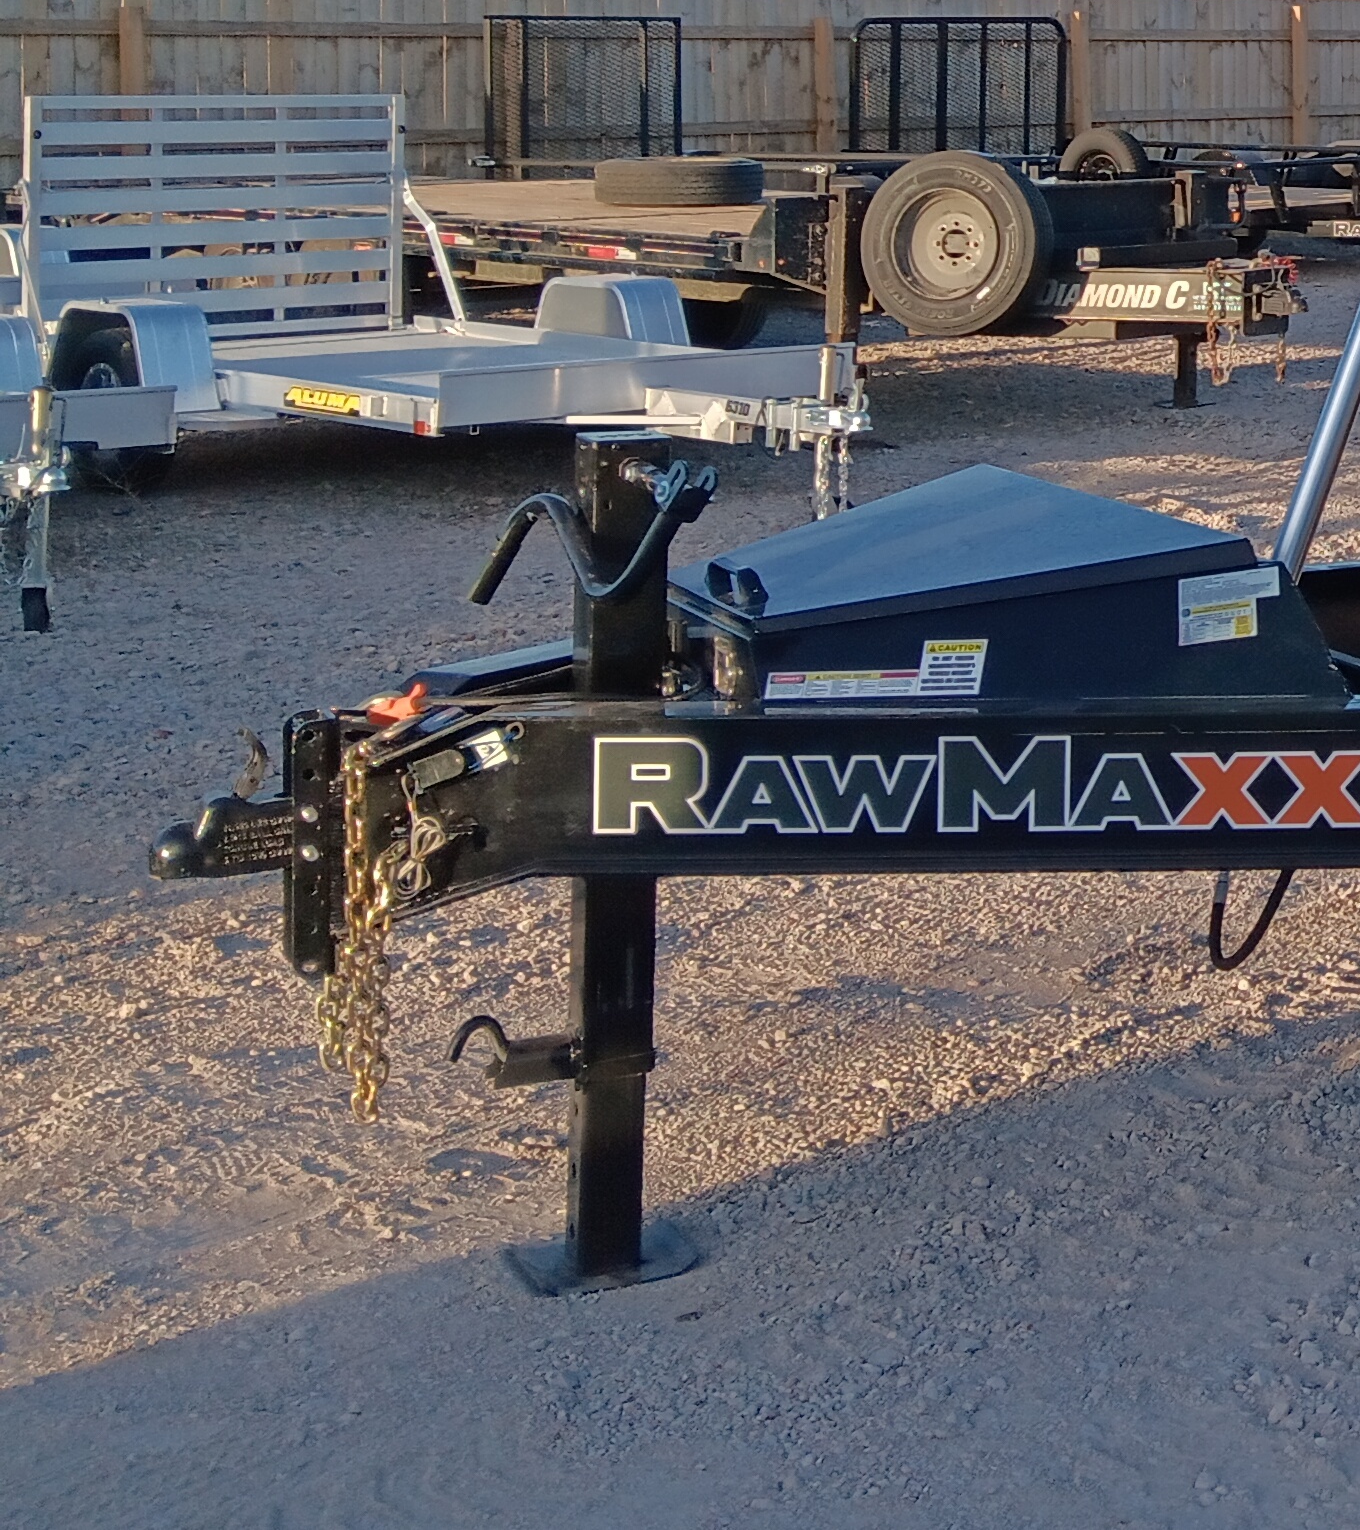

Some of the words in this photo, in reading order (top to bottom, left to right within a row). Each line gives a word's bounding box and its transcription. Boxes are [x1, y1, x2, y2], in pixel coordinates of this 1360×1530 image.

[1039, 279, 1162, 309] DIAMOND
[1165, 280, 1190, 310] C
[285, 385, 361, 414] ALUMA
[938, 644, 982, 652] CAUTION
